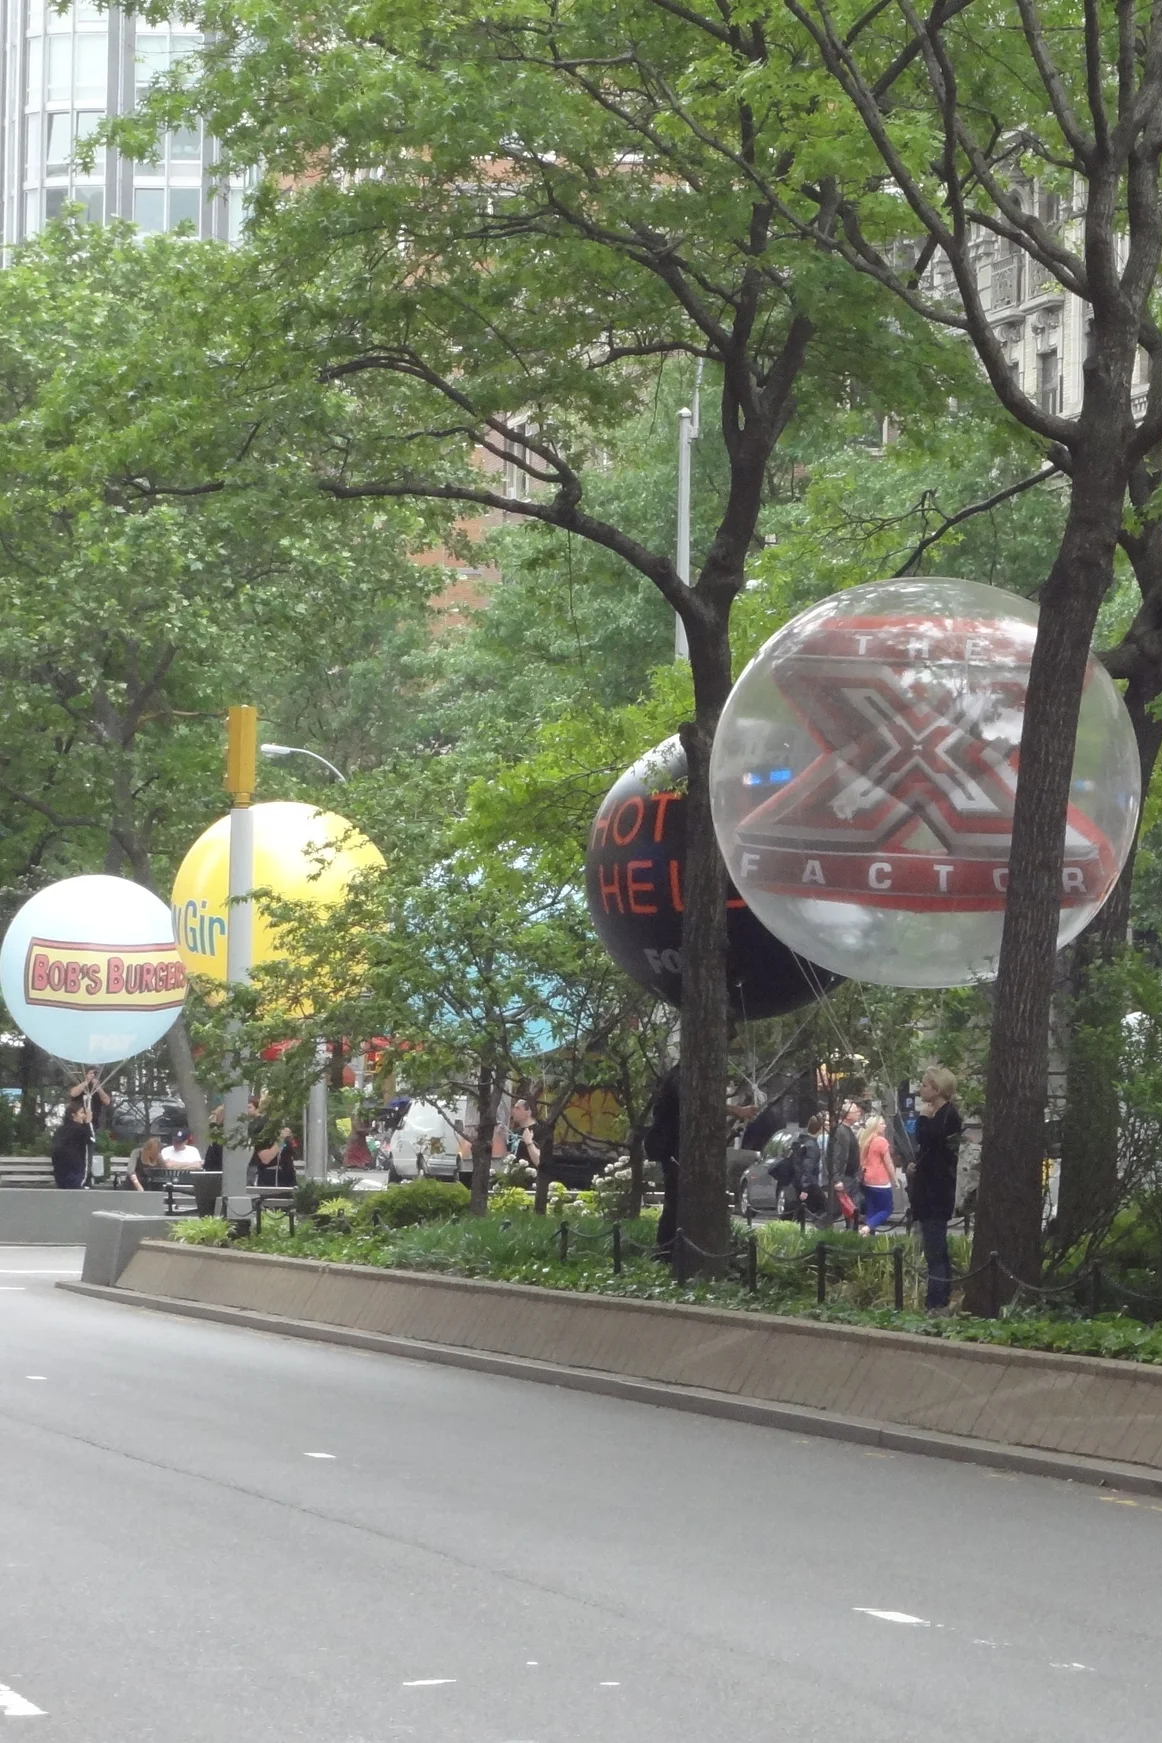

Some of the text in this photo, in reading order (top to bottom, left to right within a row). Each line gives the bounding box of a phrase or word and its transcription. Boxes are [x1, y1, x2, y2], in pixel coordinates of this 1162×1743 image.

[856, 634, 984, 659] THE
[184, 899, 226, 956] Gir
[32, 953, 103, 996] BOB'S
[643, 948, 684, 975] FO
